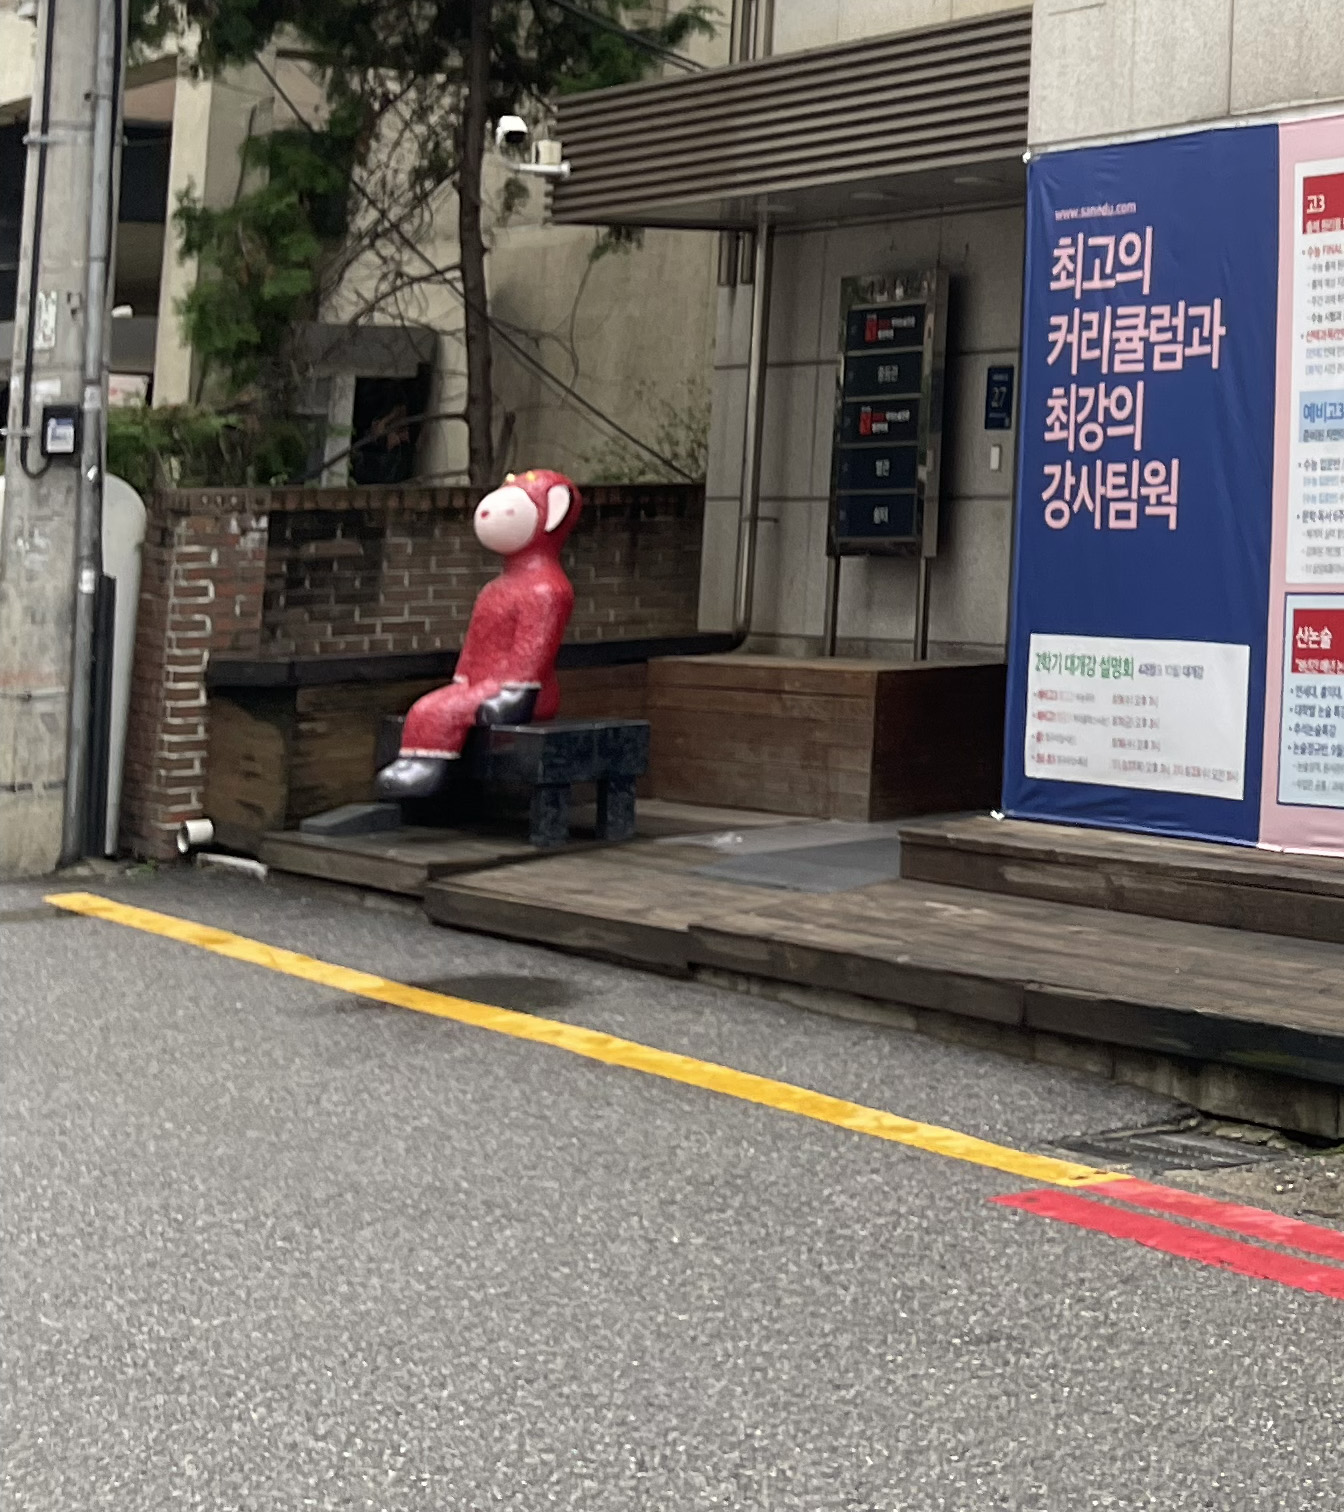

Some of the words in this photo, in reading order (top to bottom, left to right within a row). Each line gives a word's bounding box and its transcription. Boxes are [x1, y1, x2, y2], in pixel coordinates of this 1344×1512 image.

[1307, 195, 1325, 214] 고3
[1050, 226, 1153, 300] 최고의
[1047, 298, 1226, 376] 커리큘럼과
[1044, 380, 1144, 453] 최강의
[1042, 458, 1180, 530] 강사팀웍
[1296, 626, 1332, 649] 산논술
